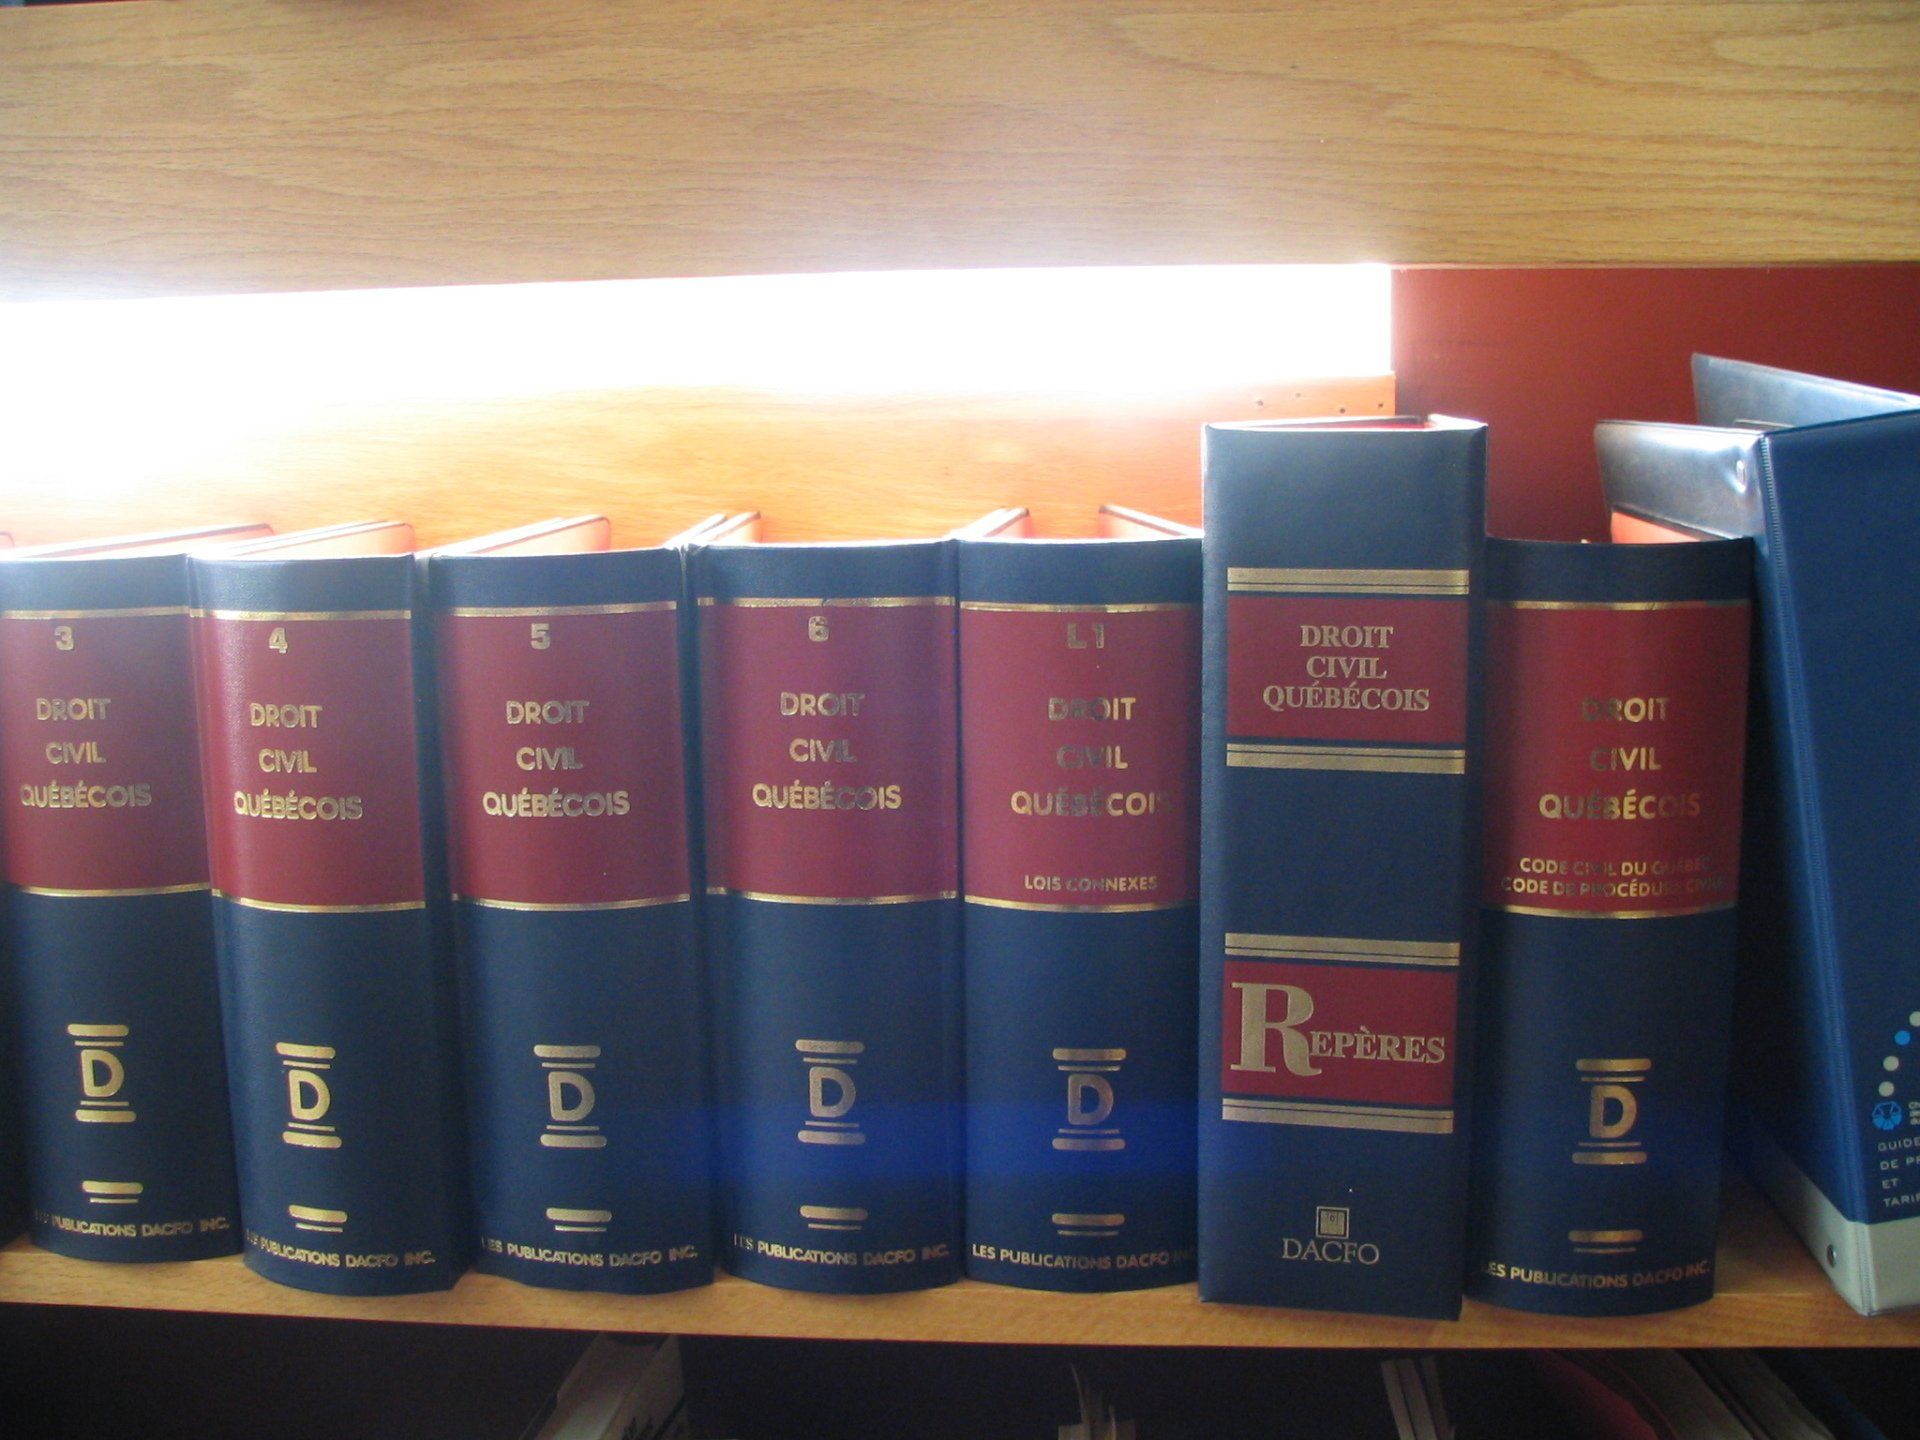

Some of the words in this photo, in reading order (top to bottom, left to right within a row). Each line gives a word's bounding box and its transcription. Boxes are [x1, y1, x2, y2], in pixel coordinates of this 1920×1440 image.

[55, 626, 74, 651] 3
[268, 628, 289, 654] 4
[530, 623, 551, 650] 5
[808, 616, 829, 642] 6
[1300, 624, 1393, 649] DROIT
[1306, 656, 1387, 679] CIVIL
[36, 698, 111, 721] DROIT
[780, 692, 865, 716] DROIT
[1048, 697, 1136, 721] DROIT
[1262, 681, 1430, 714] QUÉBÉCOIS
[1582, 697, 1669, 723] DROIT
[249, 703, 323, 728] DROIT
[505, 700, 590, 725] DROIT
[45, 742, 106, 765] CIVIL
[258, 749, 317, 774] CIVIL
[516, 747, 584, 771] CIVIL
[789, 738, 857, 763] CIVIL
[1056, 744, 1129, 769] CIVIL
[1589, 747, 1661, 771] CIVIL
[20, 780, 152, 809] QUÉBÉCOIS
[233, 788, 364, 820] QUÉBÉCOIS
[482, 787, 631, 817] QUÉBÉCOIS
[751, 779, 902, 810] QUÉBÉCOIS
[1538, 788, 1700, 820] QUÉBÉCOIS
[1520, 857, 1567, 874] CODE
[1621, 861, 1647, 876] DU
[1024, 874, 1062, 891] LOIS
[1066, 875, 1158, 892] CONNEXES
[1501, 877, 1548, 895] CODE
[1552, 881, 1576, 896] DE
[80, 1049, 125, 1098] D
[288, 1069, 330, 1121] D
[548, 1071, 596, 1122] D
[809, 1066, 856, 1118] D
[1067, 1074, 1114, 1125] D
[1589, 1084, 1637, 1138] D
[1882, 1178, 1898, 1189] ET
[52, 1215, 136, 1237] PUBLICATIONS
[260, 1237, 341, 1267] PUBLICATIONS
[507, 1243, 604, 1267] PUBLICATIONS
[757, 1240, 857, 1265] PUBLICATIONS
[972, 1243, 996, 1260] LES
[1000, 1248, 1111, 1270] PUBLICATIONS
[1116, 1252, 1169, 1269] DACFO
[1282, 1238, 1380, 1265] DACFO
[1510, 1266, 1627, 1288] PUBLICATIONS
